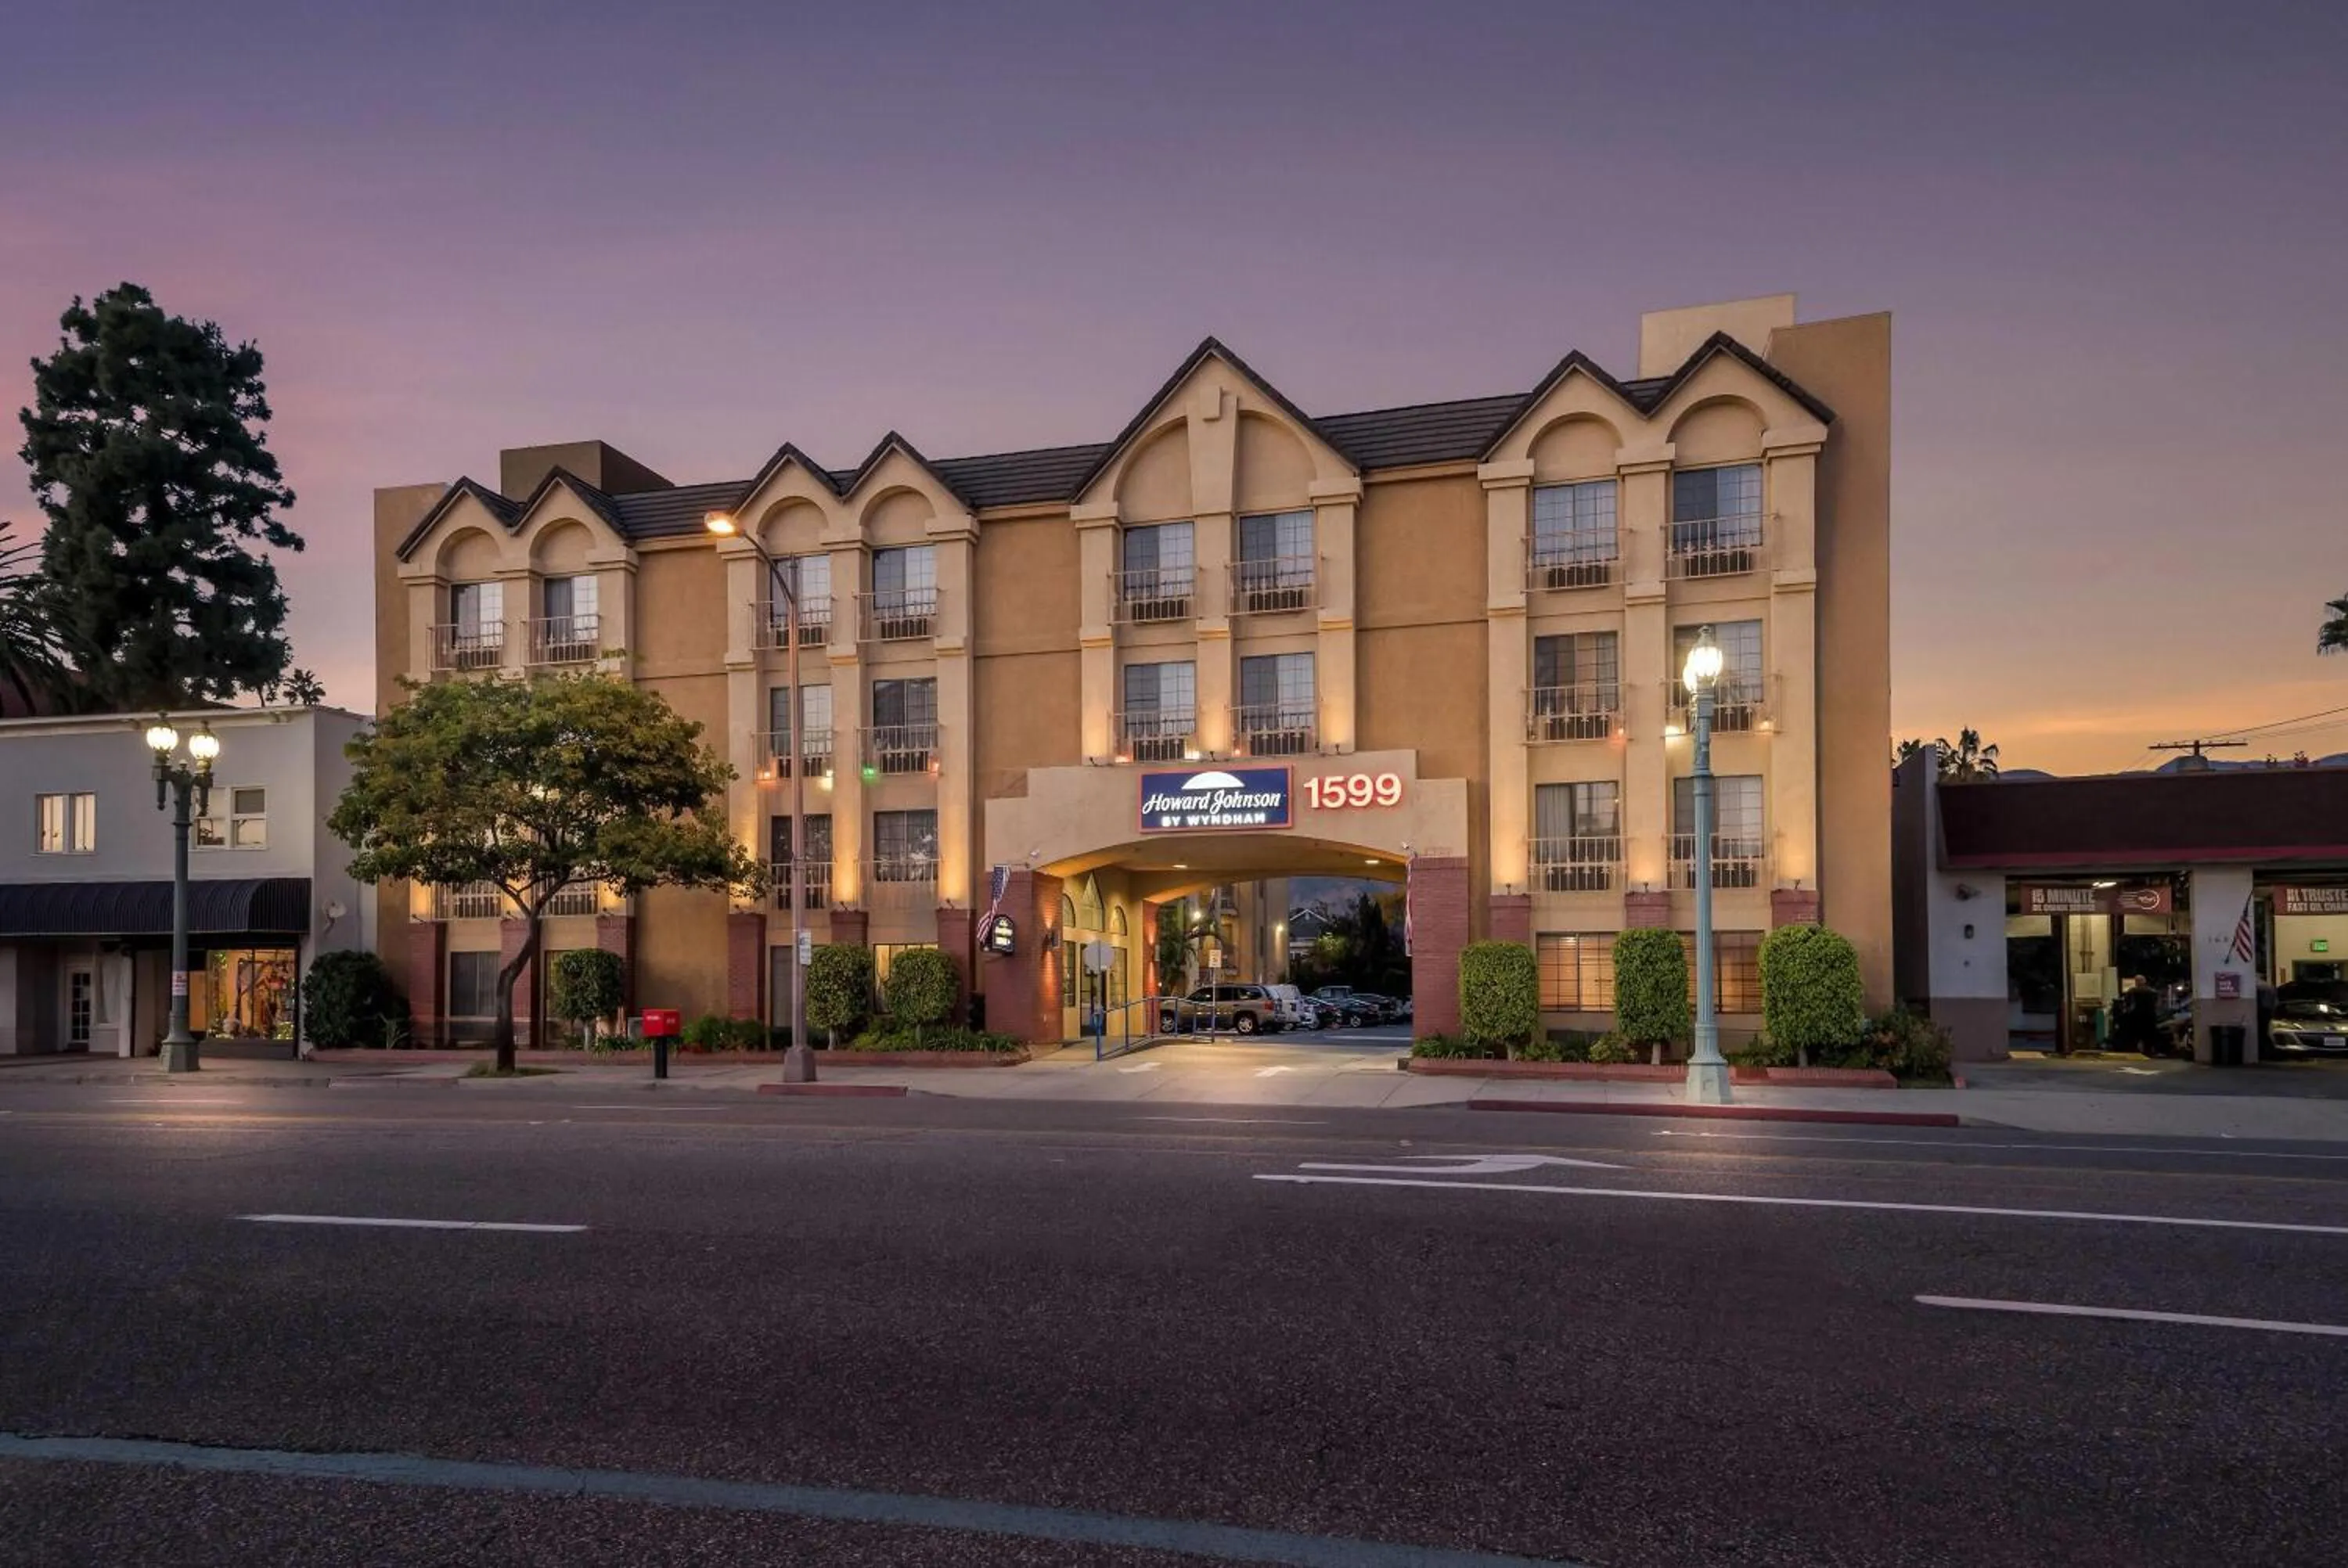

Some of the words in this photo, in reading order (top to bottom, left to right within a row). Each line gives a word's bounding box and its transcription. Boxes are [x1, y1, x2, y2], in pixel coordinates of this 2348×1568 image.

[1303, 773, 1402, 808] 1599
[1142, 791, 1211, 815] Howard
[1209, 789, 1281, 815] Johnson
[1161, 816, 1181, 827] BY
[1187, 812, 1266, 826] WYNDHAM
[2032, 889, 2044, 903] 15
[2047, 889, 2095, 903] MINUTE
